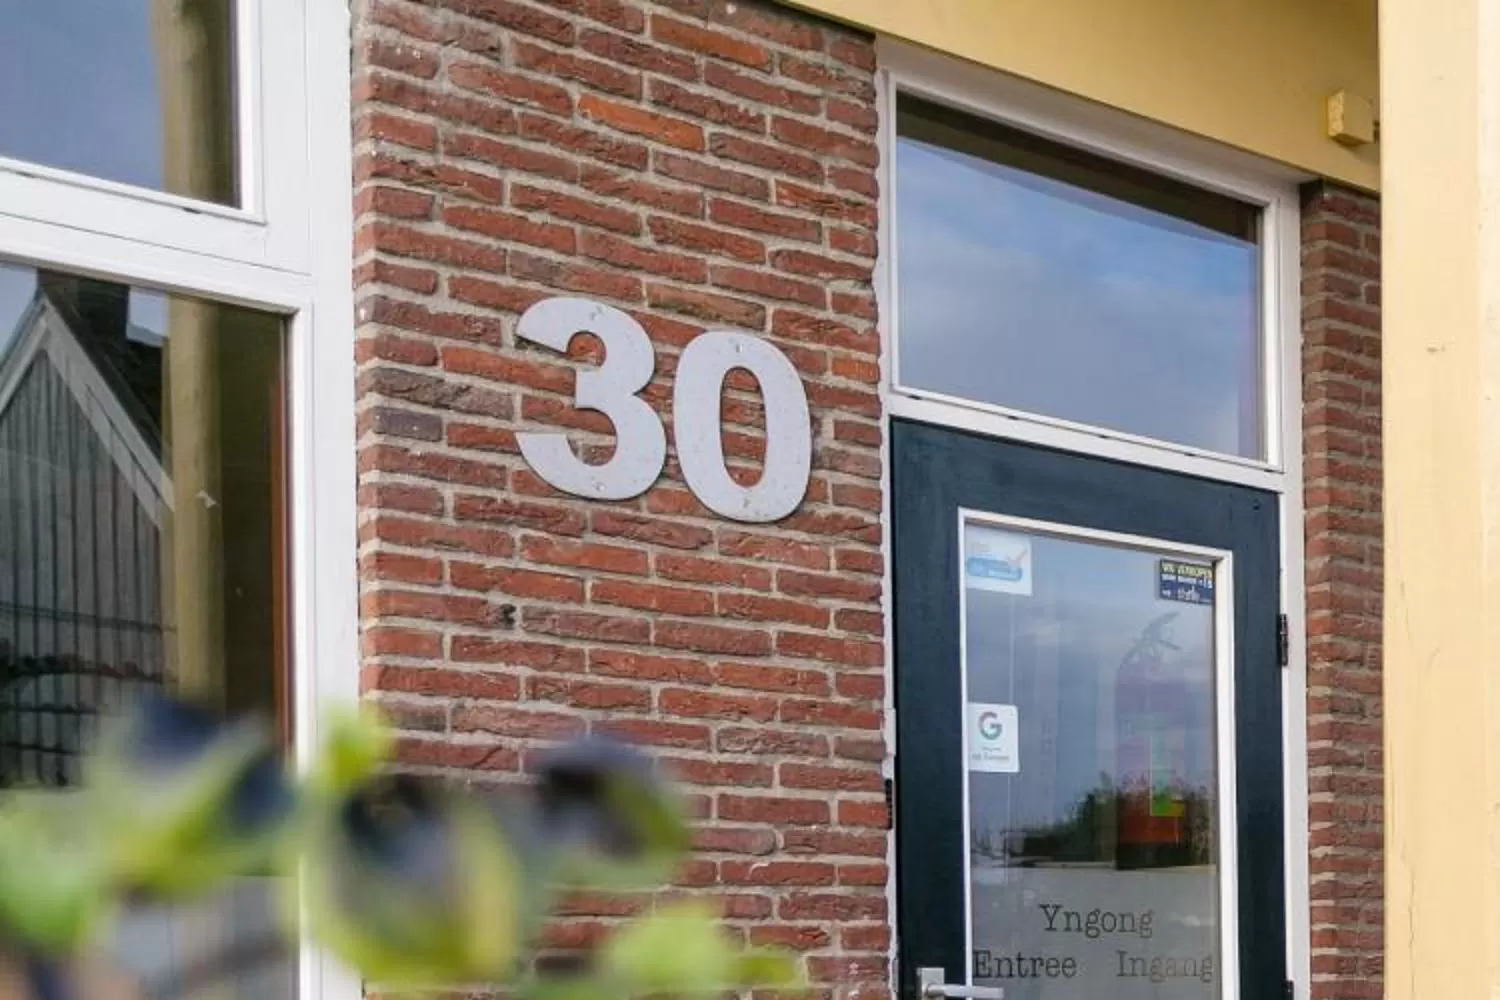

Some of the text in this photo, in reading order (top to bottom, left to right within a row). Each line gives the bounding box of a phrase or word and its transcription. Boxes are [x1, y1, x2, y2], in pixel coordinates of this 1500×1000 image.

[515, 297, 812, 523] 30
[1038, 904, 1153, 938] Yngong
[973, 950, 1214, 983] Entree Ingang
